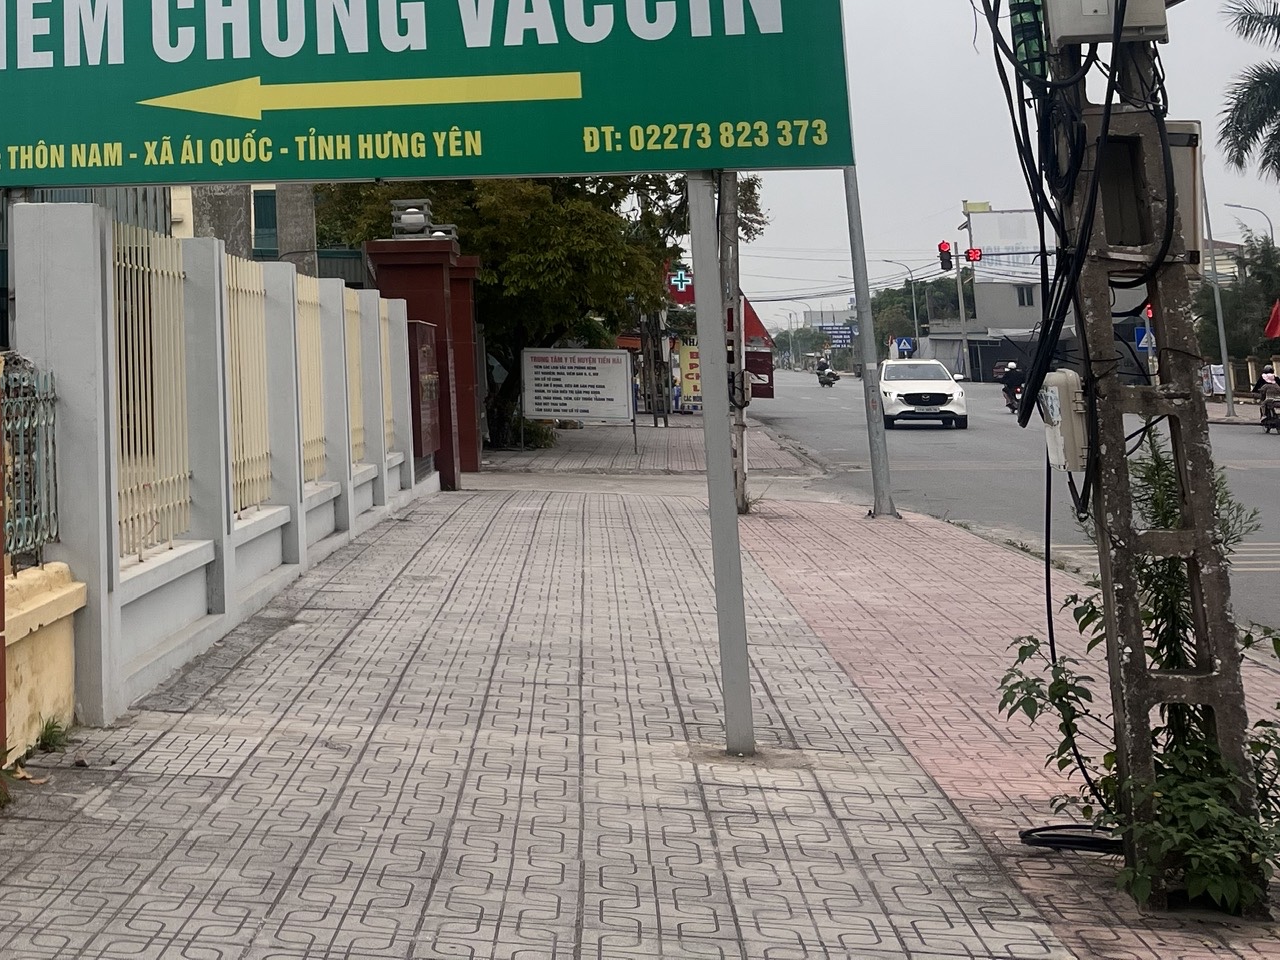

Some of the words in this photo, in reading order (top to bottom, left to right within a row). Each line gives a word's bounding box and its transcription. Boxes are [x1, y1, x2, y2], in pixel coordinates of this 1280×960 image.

[7, 139, 65, 170] THÔN
[71, 142, 123, 168] NAM
[144, 135, 175, 166] XÃ
[180, 134, 204, 165] ÁI
[210, 129, 273, 167] QUỐC
[279, 146, 289, 154] -
[295, 127, 351, 161] TỈNH
[358, 130, 426, 160] HƯNG
[432, 125, 482, 157] YÊN
[583, 126, 622, 152] ĐT:
[629, 123, 712, 151] 02273
[720, 120, 770, 148] 823
[776, 119, 828, 146] 373
